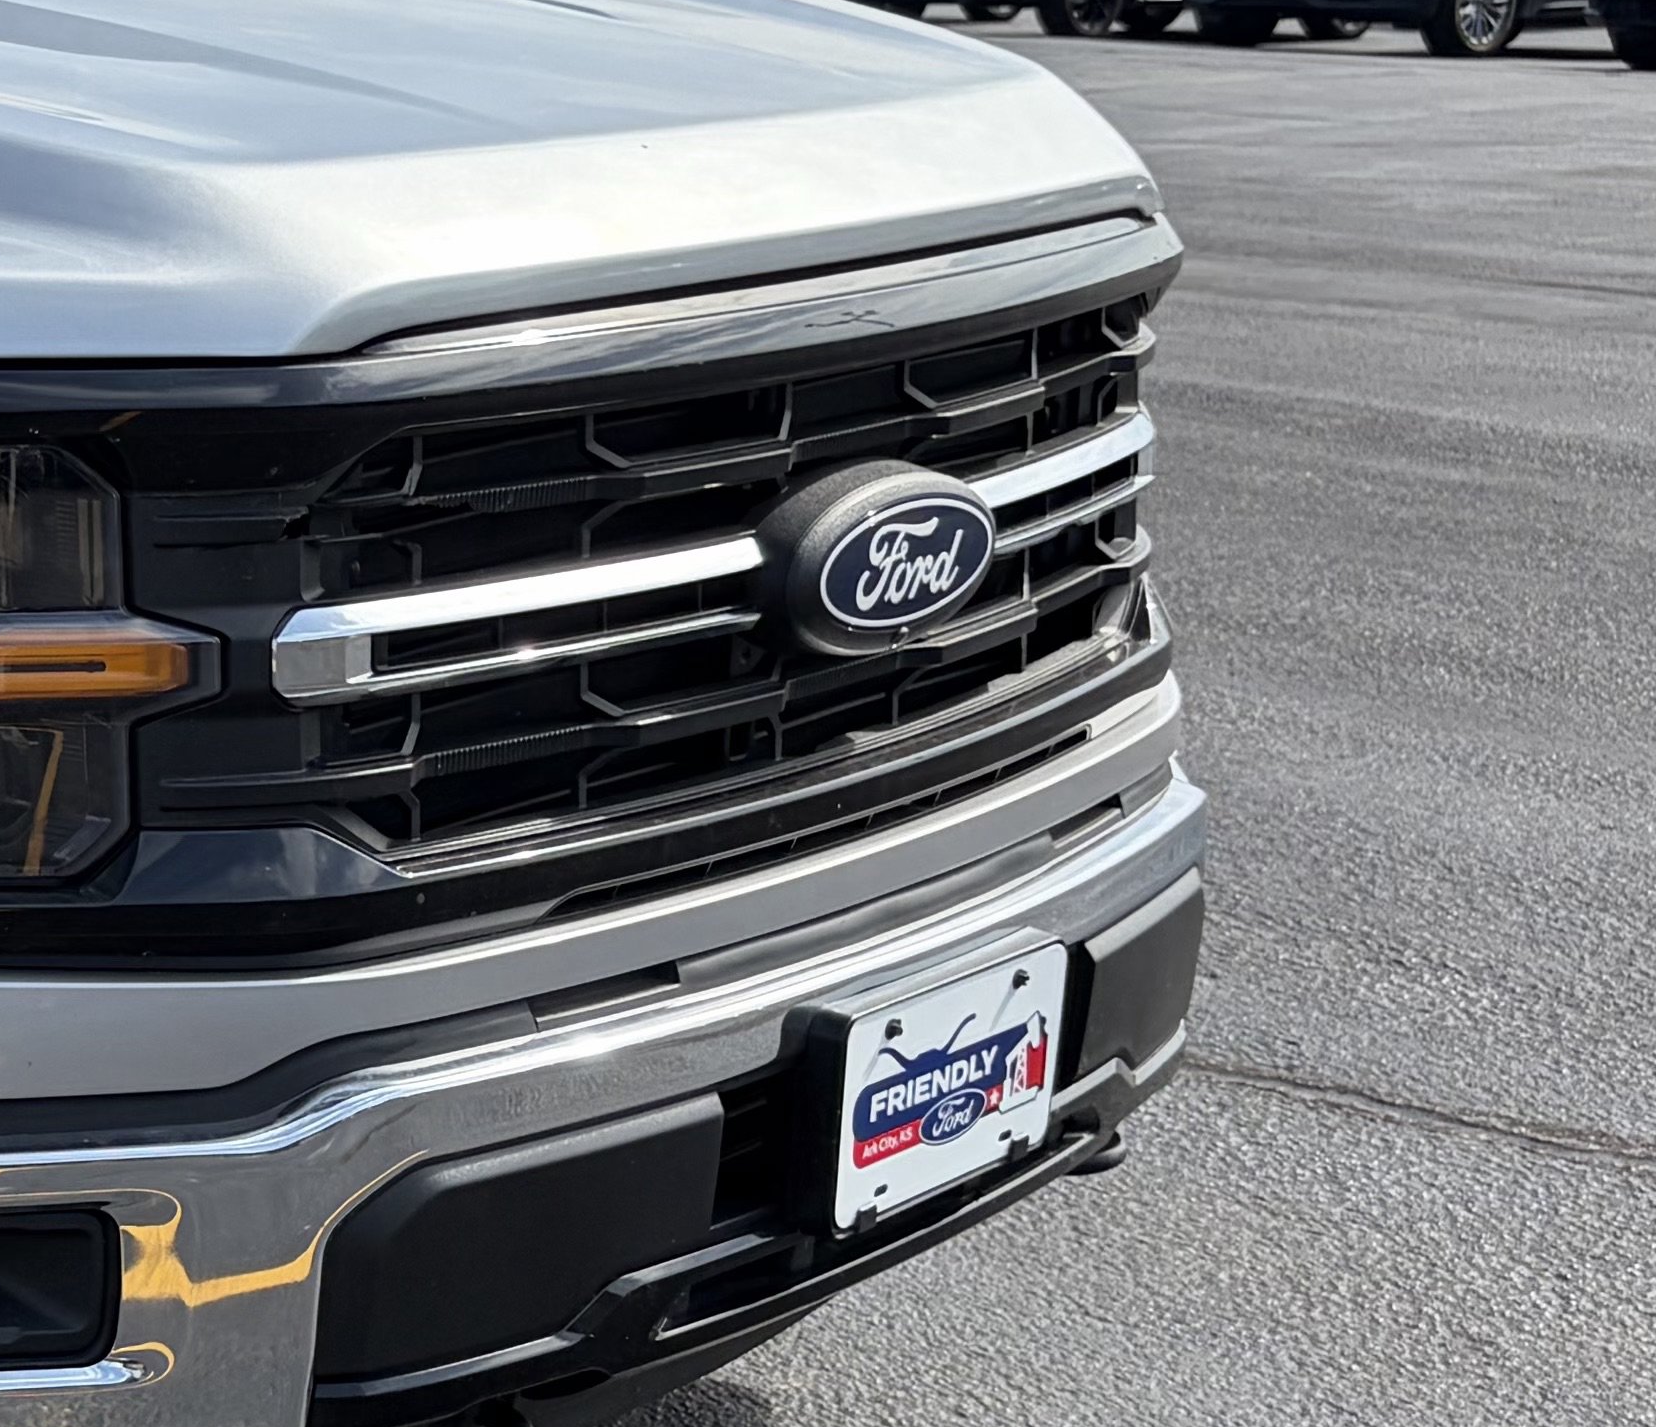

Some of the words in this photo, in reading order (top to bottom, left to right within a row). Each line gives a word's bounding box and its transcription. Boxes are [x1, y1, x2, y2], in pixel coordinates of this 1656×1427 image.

[856, 516, 964, 612] Ford
[869, 1044, 999, 1124] FRIENDLY
[932, 1096, 975, 1138] Ford
